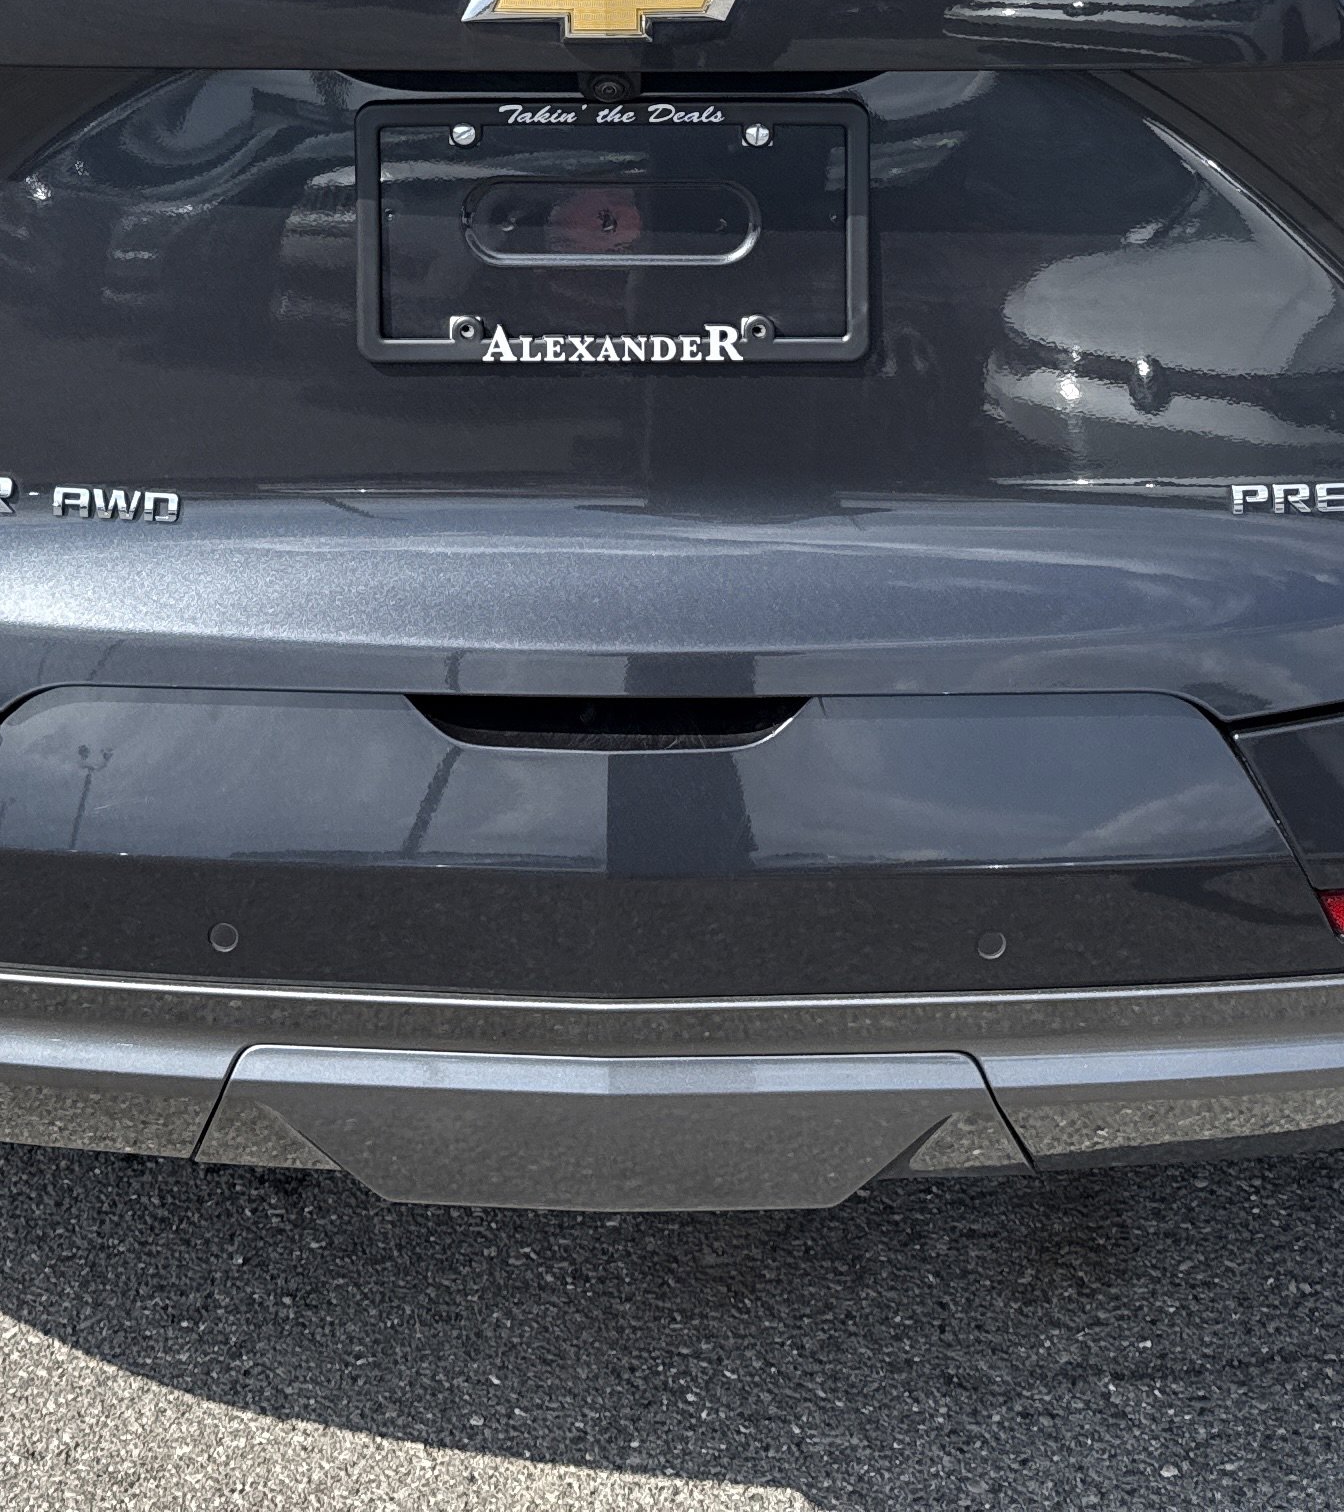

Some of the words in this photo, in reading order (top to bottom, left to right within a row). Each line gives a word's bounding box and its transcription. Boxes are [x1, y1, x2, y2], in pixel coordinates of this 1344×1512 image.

[498, 104, 586, 124] Takin'
[596, 104, 635, 123] the
[648, 104, 725, 124] Deals
[52, 486, 182, 523] AWD
